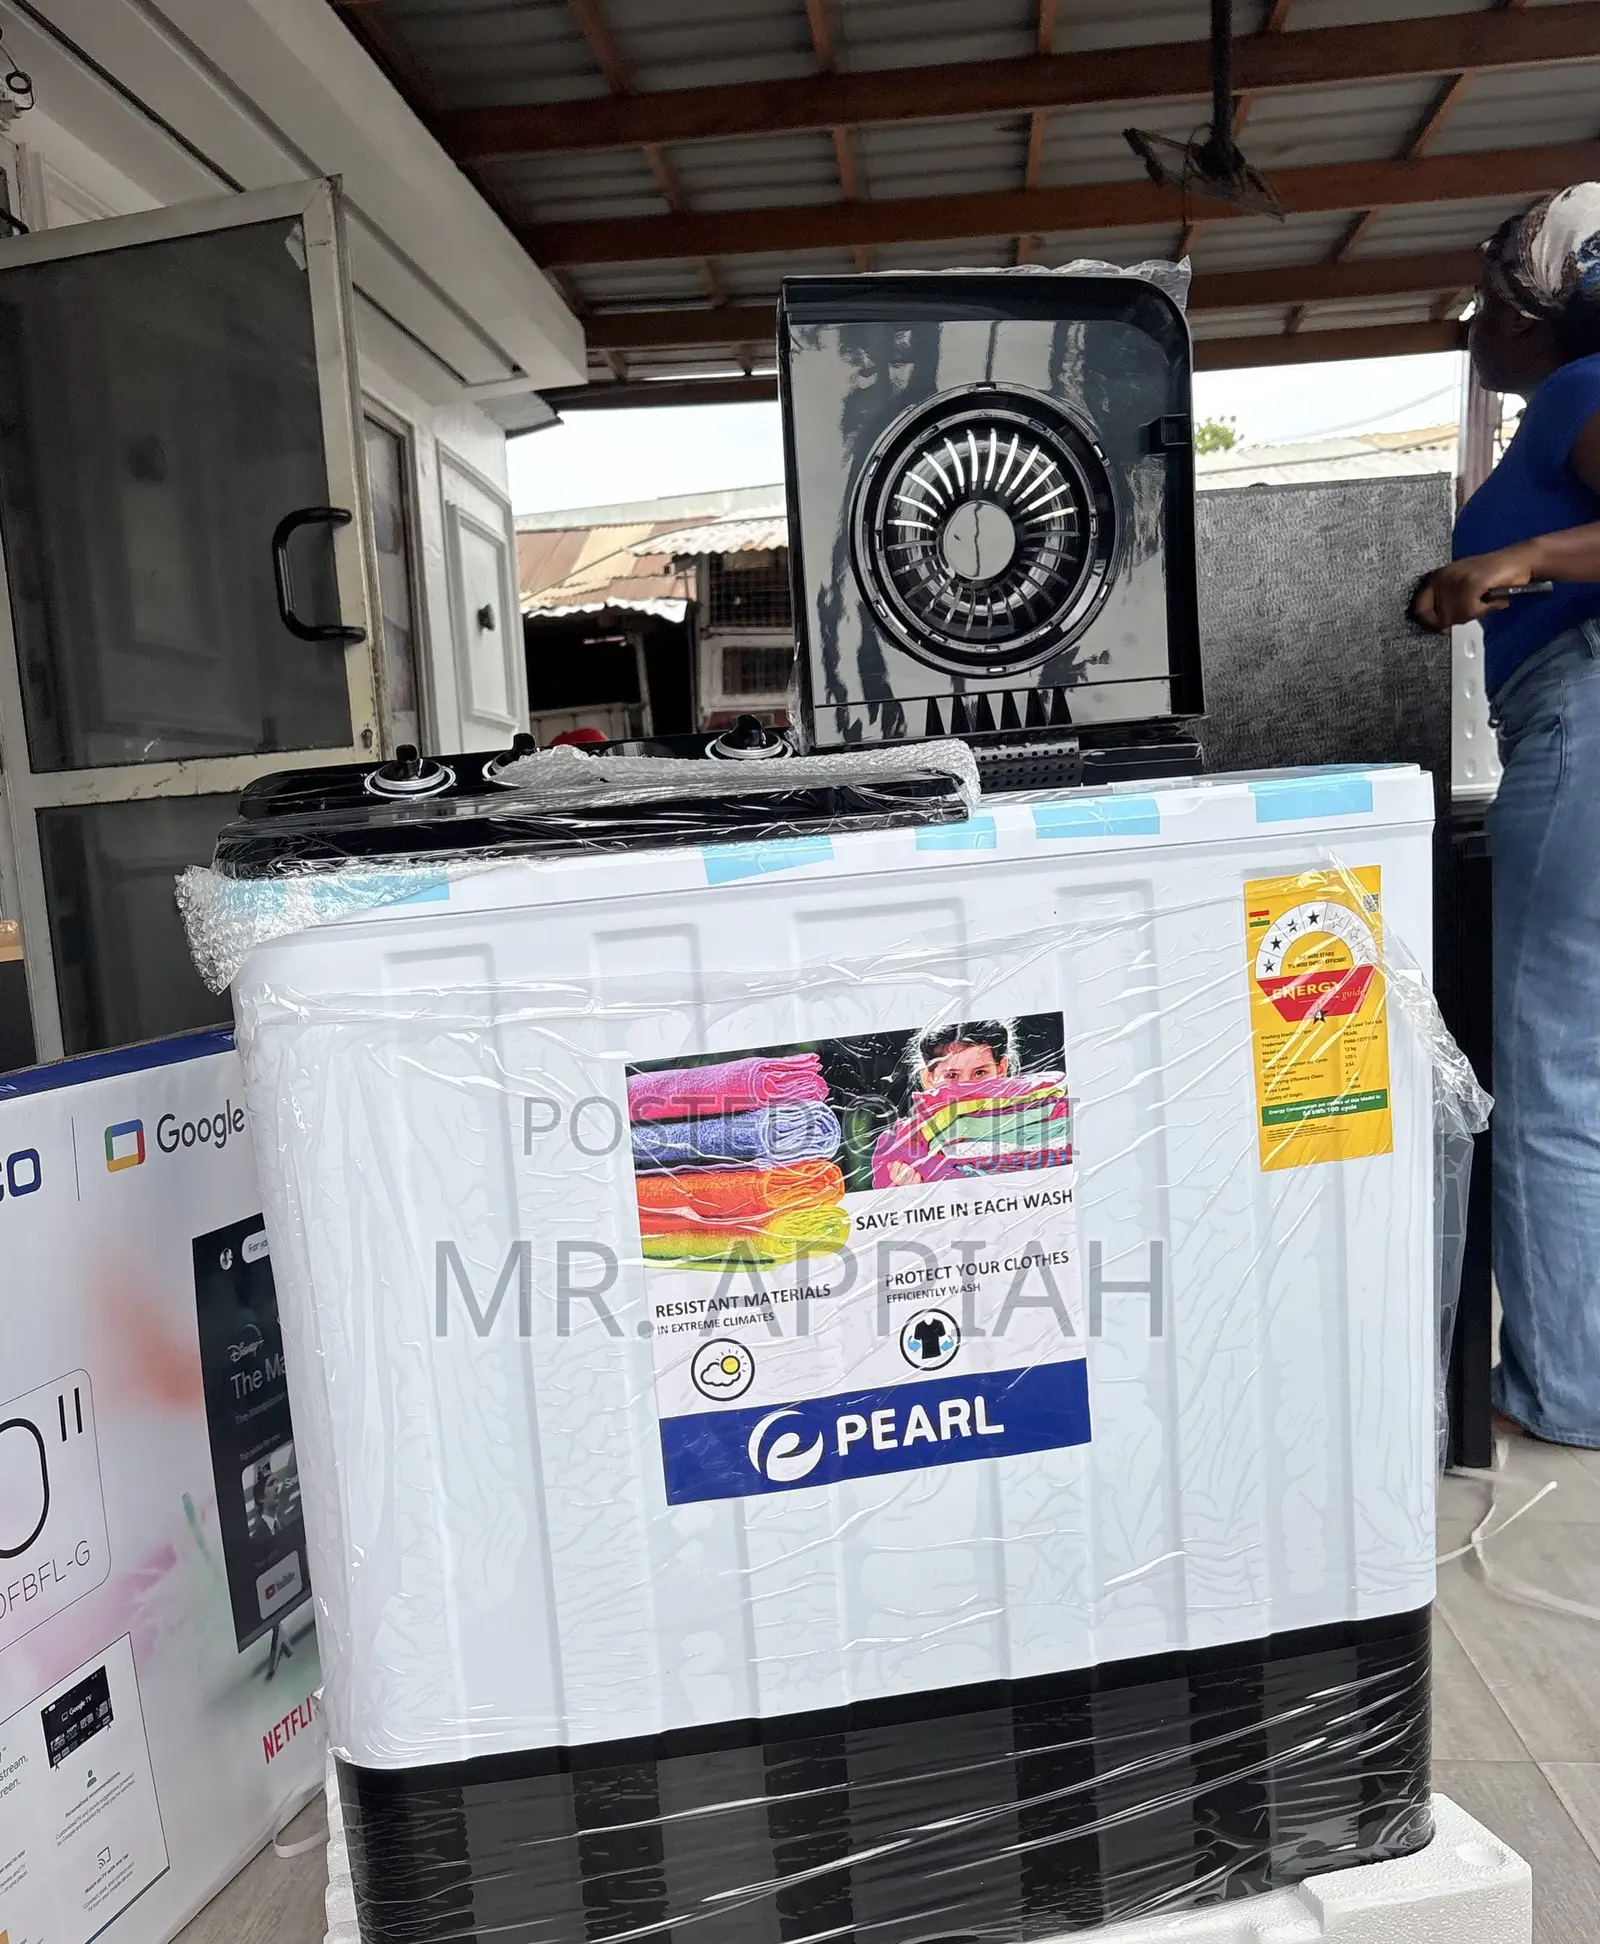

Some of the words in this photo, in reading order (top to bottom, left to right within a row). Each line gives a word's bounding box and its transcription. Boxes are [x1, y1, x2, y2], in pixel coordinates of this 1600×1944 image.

[1272, 982, 1340, 1001] ENERGY
[1315, 1010, 1322, 1019] 4
[156, 1098, 245, 1154] Google
[1269, 1108, 1285, 1116] Energy
[0, 1148, 42, 1202] o
[856, 1212, 899, 1231] SAVE
[904, 1205, 946, 1225] TIME
[951, 1203, 969, 1218] IN
[974, 1196, 1018, 1215] EACH
[1023, 1189, 1074, 1209] WASH
[885, 1265, 952, 1288] PROTECT
[955, 1261, 1000, 1278] YOUR
[1004, 1251, 1069, 1271] CLOTHES
[656, 1296, 740, 1318] RESISTANT
[744, 1283, 832, 1308] MATERIALS
[886, 1286, 947, 1305] EFFICIENTLY
[948, 1283, 981, 1295] WASH
[657, 1325, 669, 1335] IN
[672, 1318, 721, 1333] EXTREME
[723, 1312, 775, 1327] CLIMATES
[230, 1369, 263, 1400] The
[265, 1353, 286, 1382] Ma
[836, 1396, 1005, 1456] PEARL
[68, 1698, 86, 1716] Google
[85, 1694, 92, 1704] TV
[262, 1697, 313, 1765] NETFLI
[0, 1778, 21, 1799] reen.
